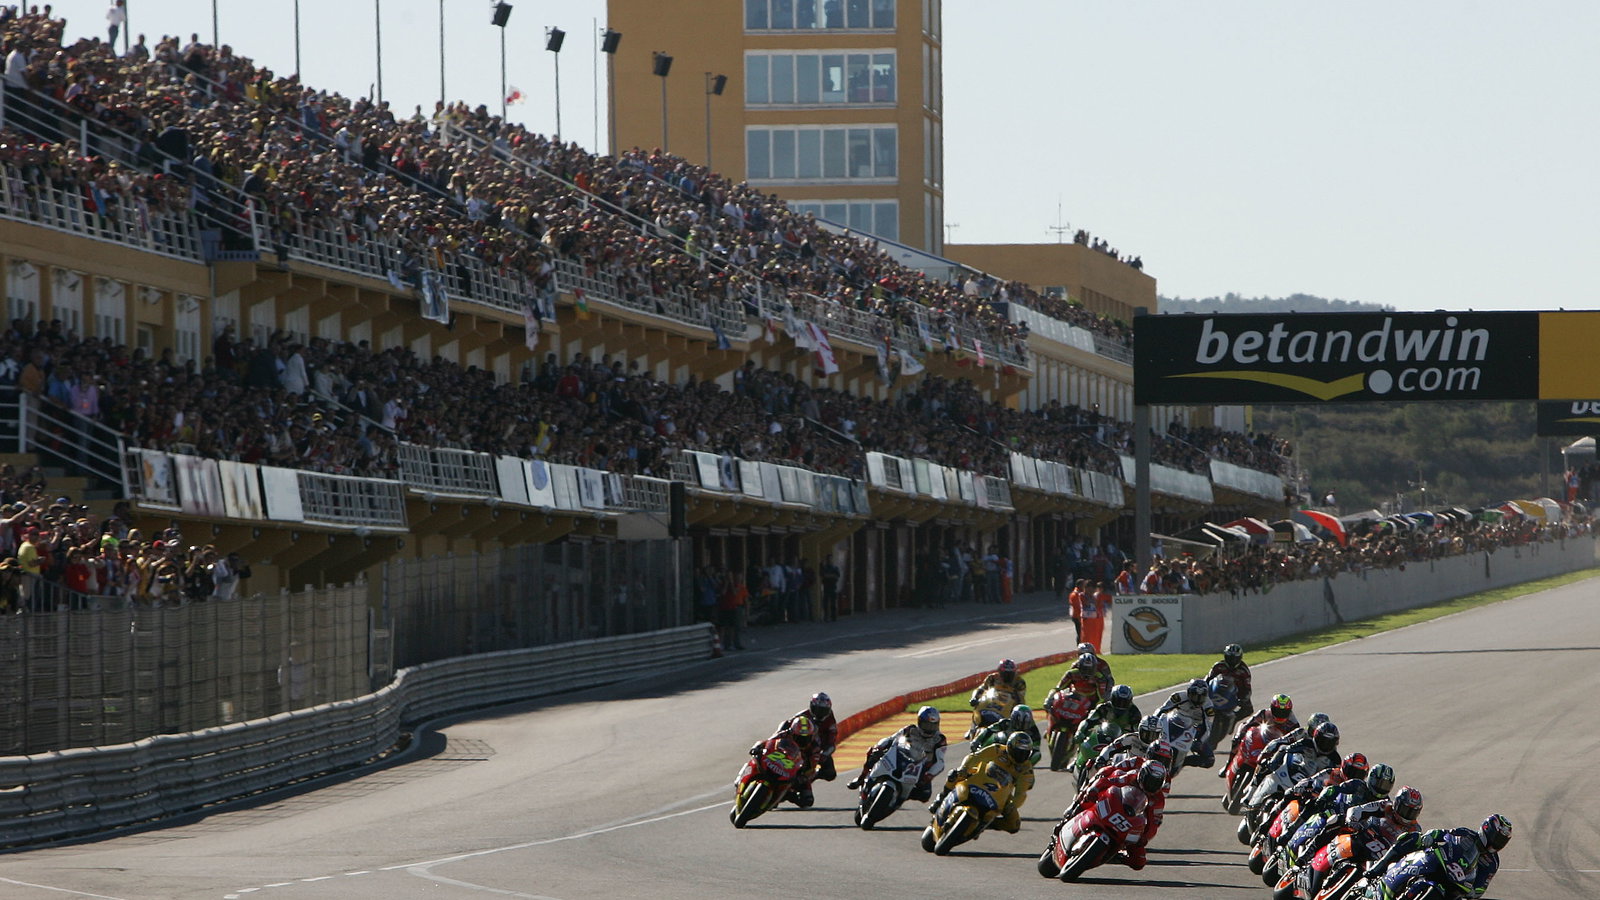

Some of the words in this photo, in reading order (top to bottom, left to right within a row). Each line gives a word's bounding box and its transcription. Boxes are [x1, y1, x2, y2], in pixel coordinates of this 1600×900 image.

[1195, 316, 1489, 364] betandwin
[767, 751, 795, 769] 24
[969, 786, 995, 809] CAMEL
[1109, 812, 1133, 832] 65
